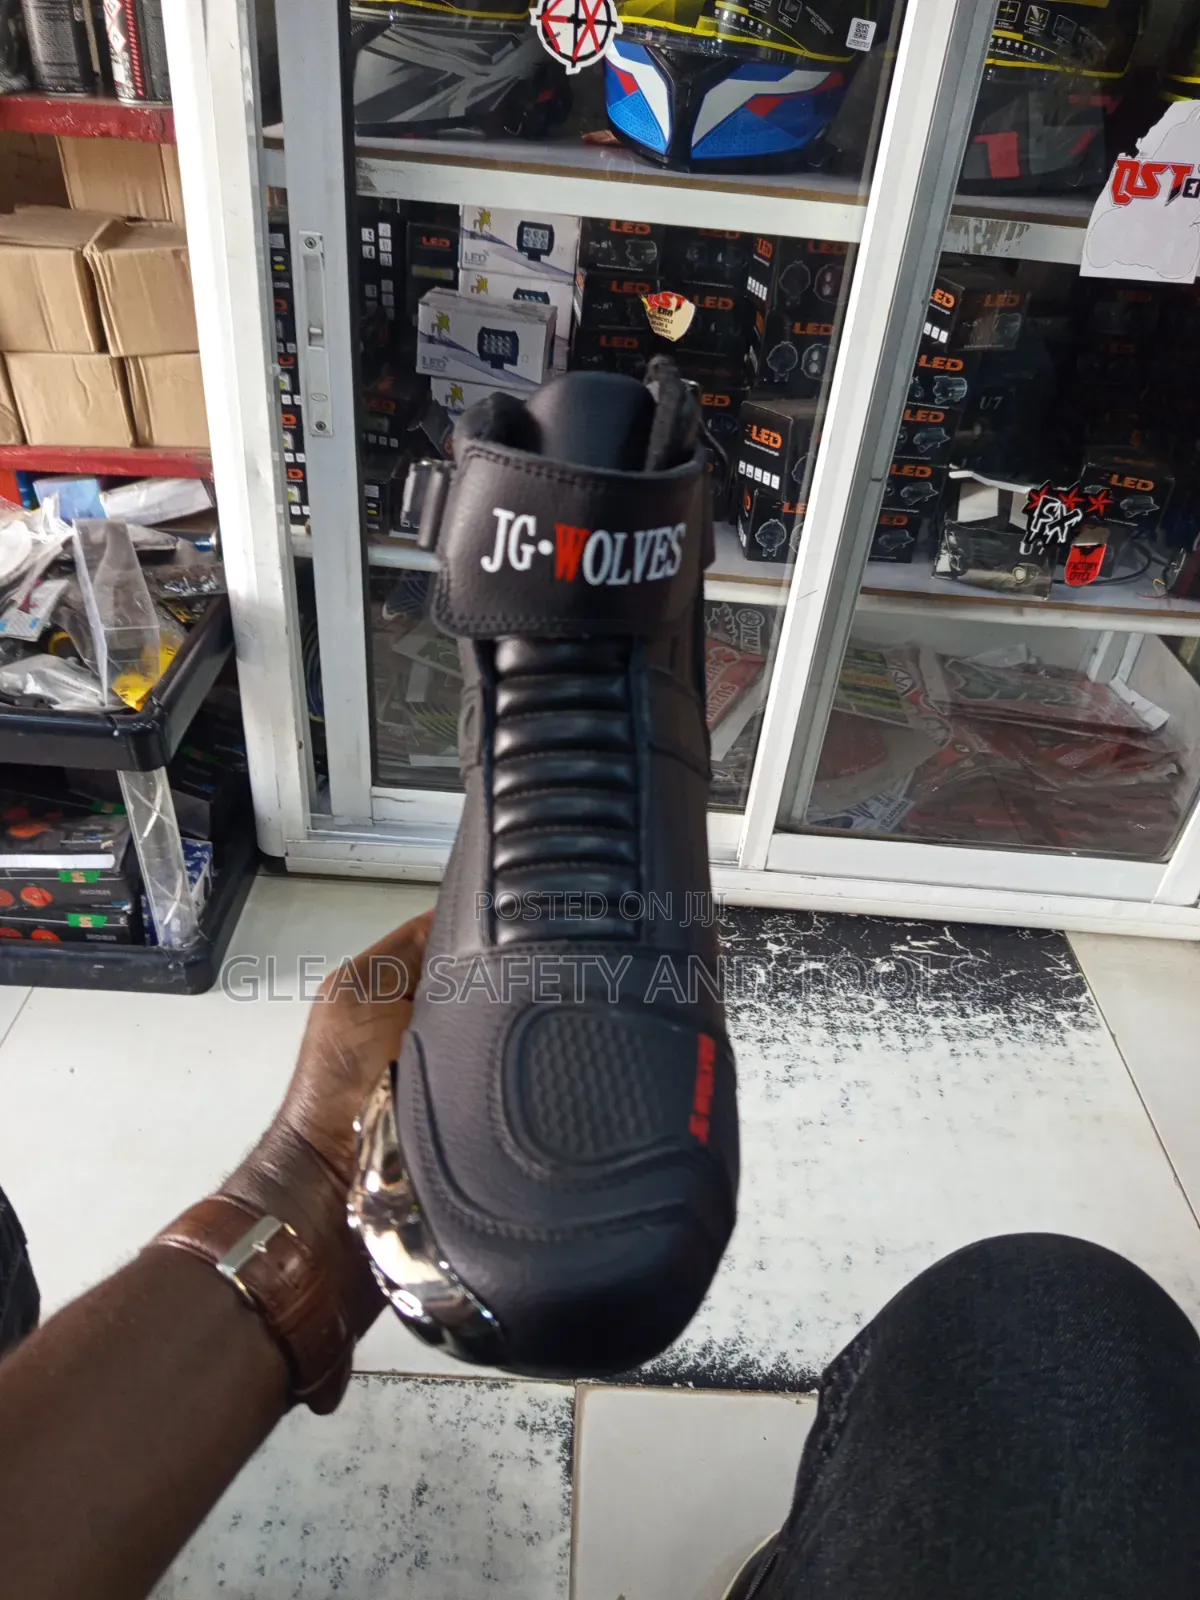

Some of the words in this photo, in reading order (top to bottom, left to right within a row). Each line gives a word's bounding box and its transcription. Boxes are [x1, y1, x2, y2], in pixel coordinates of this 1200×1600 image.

[608, 219, 651, 234] LED
[421, 236, 451, 248] LED
[464, 252, 487, 264] LED
[611, 281, 650, 294] LED
[694, 295, 735, 310] LED
[984, 294, 1021, 307] LED
[793, 322, 835, 336] LED
[601, 335, 639, 348] LED
[918, 354, 964, 371] LED
[904, 409, 945, 423] LED
[750, 424, 783, 449] LED
[890, 464, 932, 478] LED
[1110, 474, 1155, 492] LED
